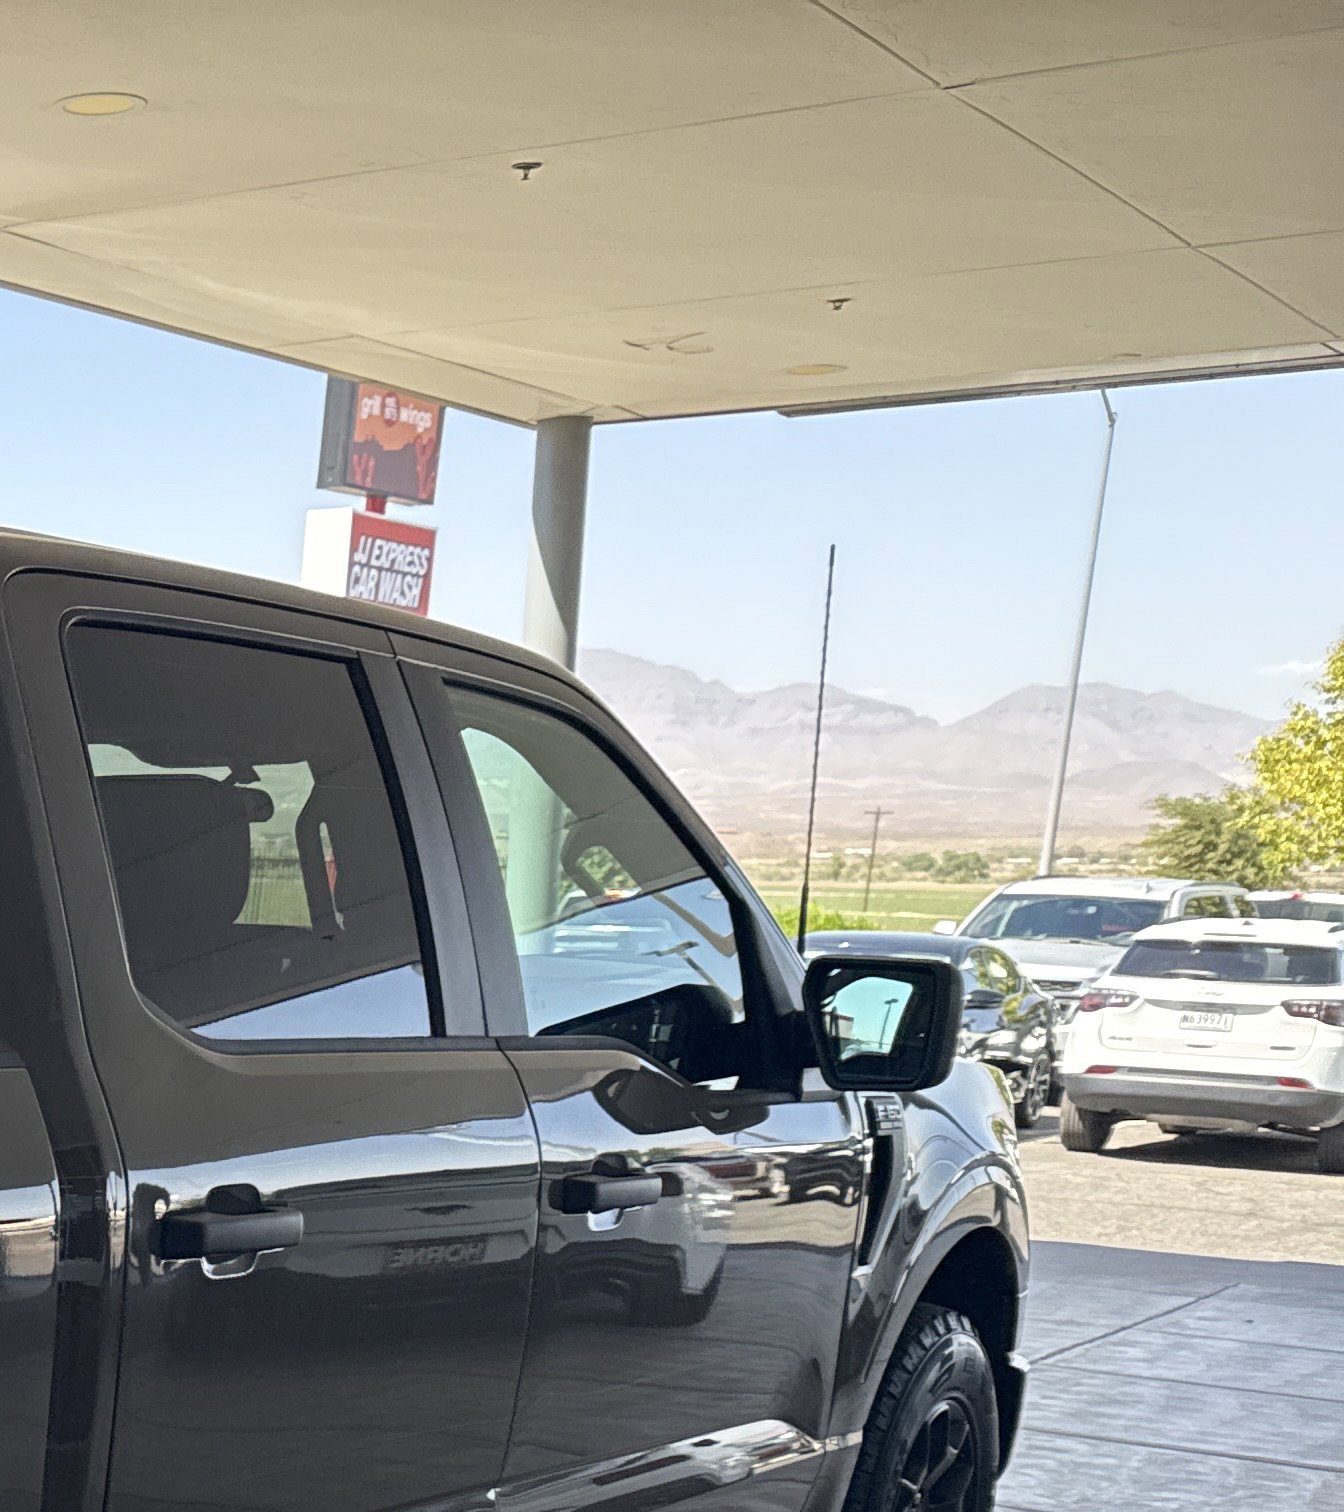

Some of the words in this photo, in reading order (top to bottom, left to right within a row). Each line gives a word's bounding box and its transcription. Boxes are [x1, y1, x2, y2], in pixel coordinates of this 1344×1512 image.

[400, 403, 433, 433] wings
[353, 535, 373, 564] JJ
[370, 538, 430, 576] EXPRESS
[349, 564, 379, 601] CAR
[378, 570, 424, 608] WASH
